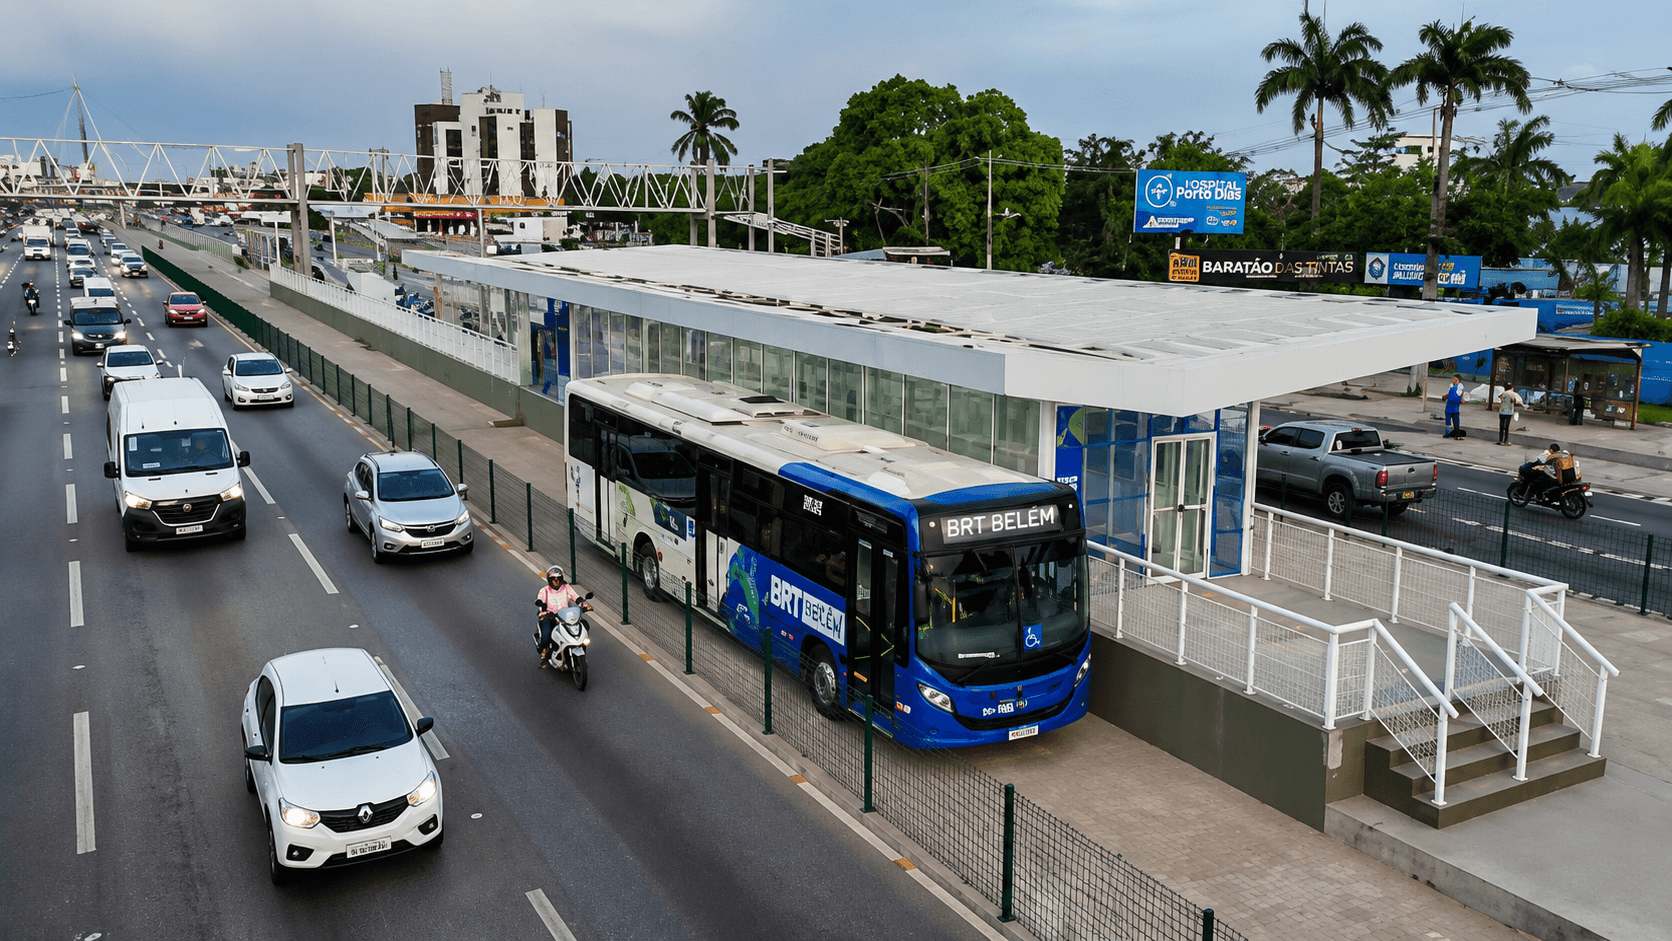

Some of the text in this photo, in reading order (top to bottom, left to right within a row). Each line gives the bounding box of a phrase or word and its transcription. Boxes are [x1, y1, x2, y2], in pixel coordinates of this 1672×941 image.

[1176, 186, 1212, 200] Porto
[1202, 258, 1273, 274] BARATÃO
[1274, 262, 1303, 274] DAS
[1305, 261, 1354, 274] TINTAS
[947, 505, 1055, 537] BRT BELÉM
[770, 574, 803, 618] BRT
